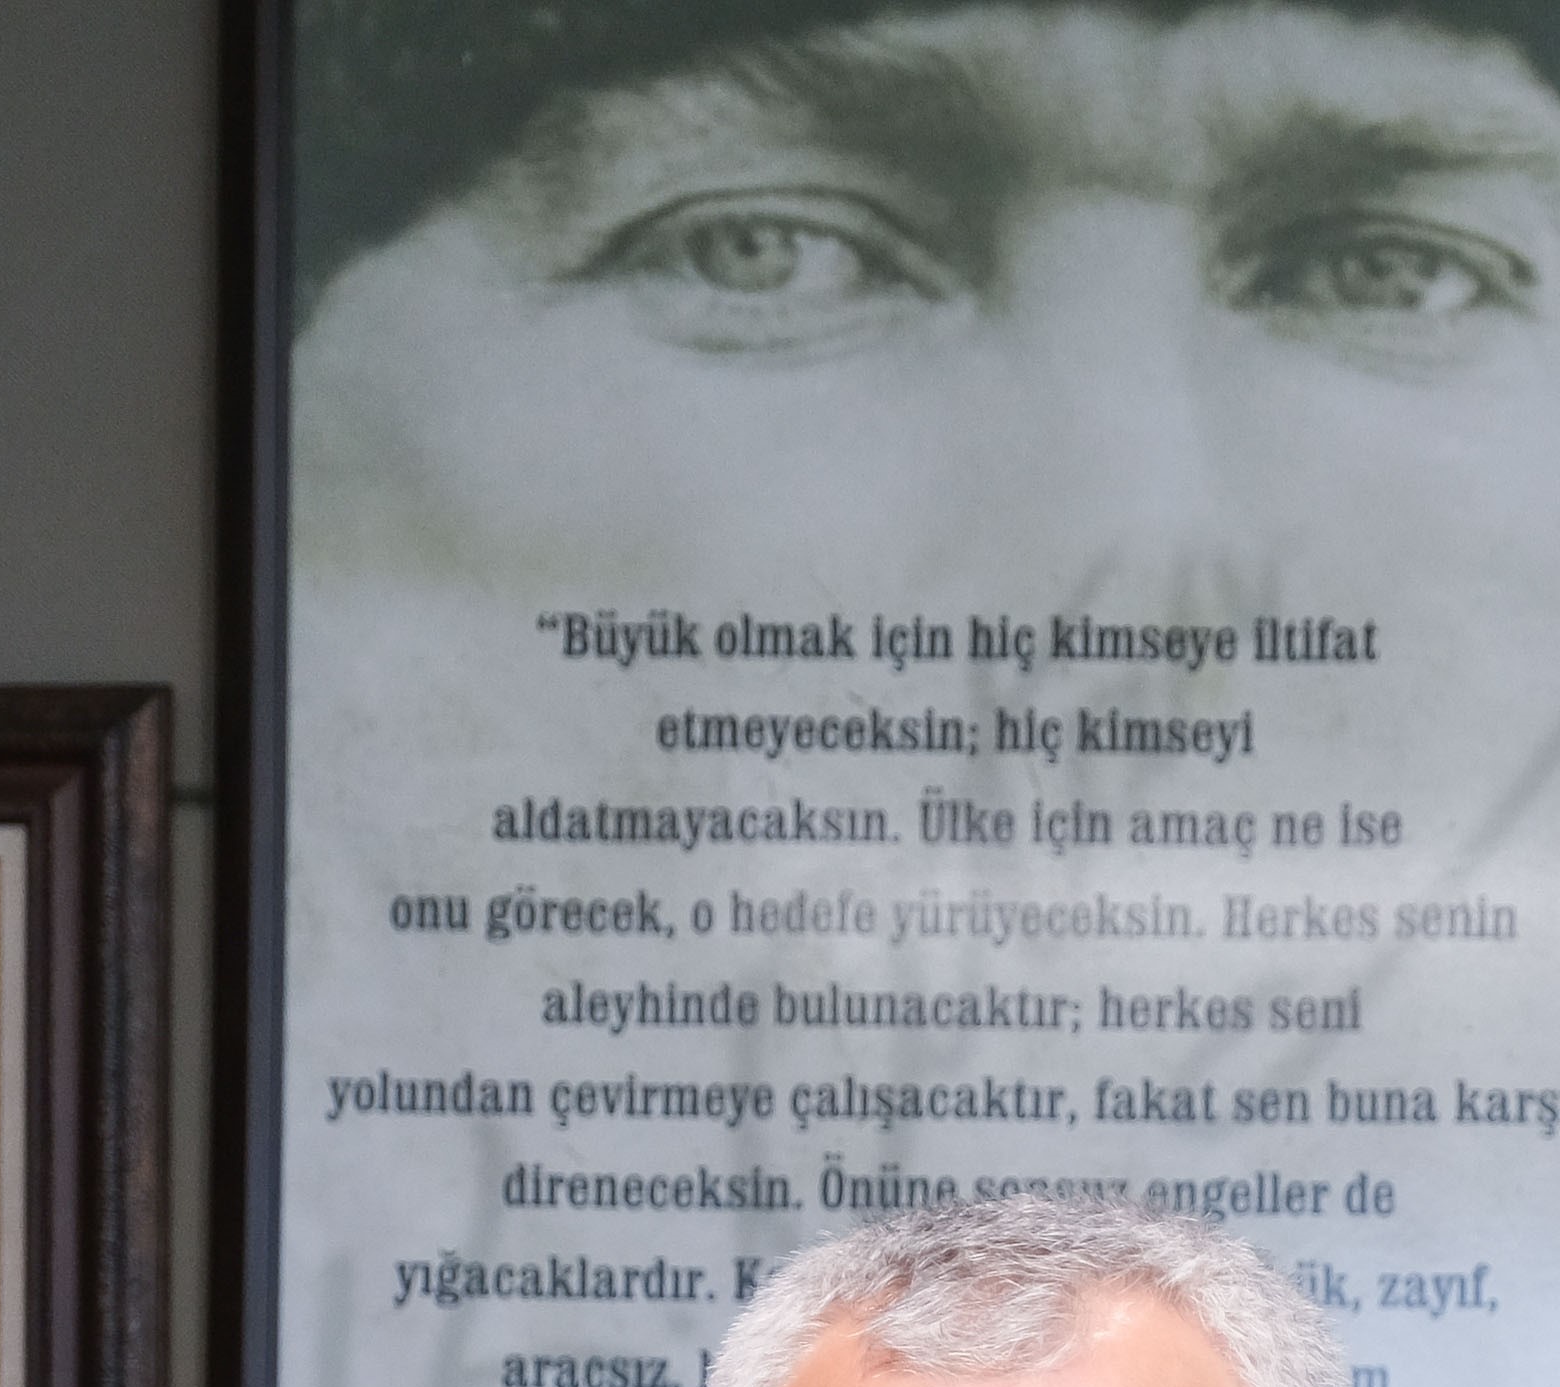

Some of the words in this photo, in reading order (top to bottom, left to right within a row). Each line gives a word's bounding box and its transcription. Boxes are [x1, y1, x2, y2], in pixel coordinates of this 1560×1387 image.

[714, 612, 857, 660] olmak
[871, 614, 953, 672] için
[968, 614, 1035, 672] hiç
[1048, 614, 1238, 672] kimseye
[1253, 616, 1378, 664] iltifat
[655, 707, 979, 761] etmeyeceksin;
[994, 707, 1062, 765] hiç
[1076, 708, 1254, 766] kimseyi
[492, 795, 902, 854] aldatmayacaksın.
[918, 786, 1016, 849] Ülke
[1032, 799, 1113, 857] için
[1129, 811, 1256, 857] amaç
[1271, 812, 1325, 848] ne
[1339, 802, 1403, 848] ise
[389, 894, 471, 932] onu
[485, 885, 676, 943] görecek,
[690, 899, 715, 936] o
[889, 894, 1206, 947] yürüyeceksin.
[1394, 897, 1519, 943] senin
[541, 979, 760, 1036] aleyhinde
[773, 982, 1082, 1034] bulunacaktır;
[1098, 984, 1254, 1033] herkes
[1268, 985, 1363, 1034] seni
[325, 1069, 534, 1123] yolundan
[549, 1073, 774, 1129] çevirmeye
[790, 1074, 1078, 1131] çalışacaktır,
[1093, 1077, 1218, 1125] fakat
[1231, 1087, 1311, 1126] sen
[1327, 1080, 1439, 1125] buna
[501, 1163, 803, 1213] direneceksin.
[819, 1152, 961, 1213] Önüne
[1146, 1170, 1331, 1222] engeller
[1345, 1172, 1397, 1217] de
[392, 1250, 716, 1307] yığacaklardır.
[1378, 1262, 1498, 1318] zayıf,
